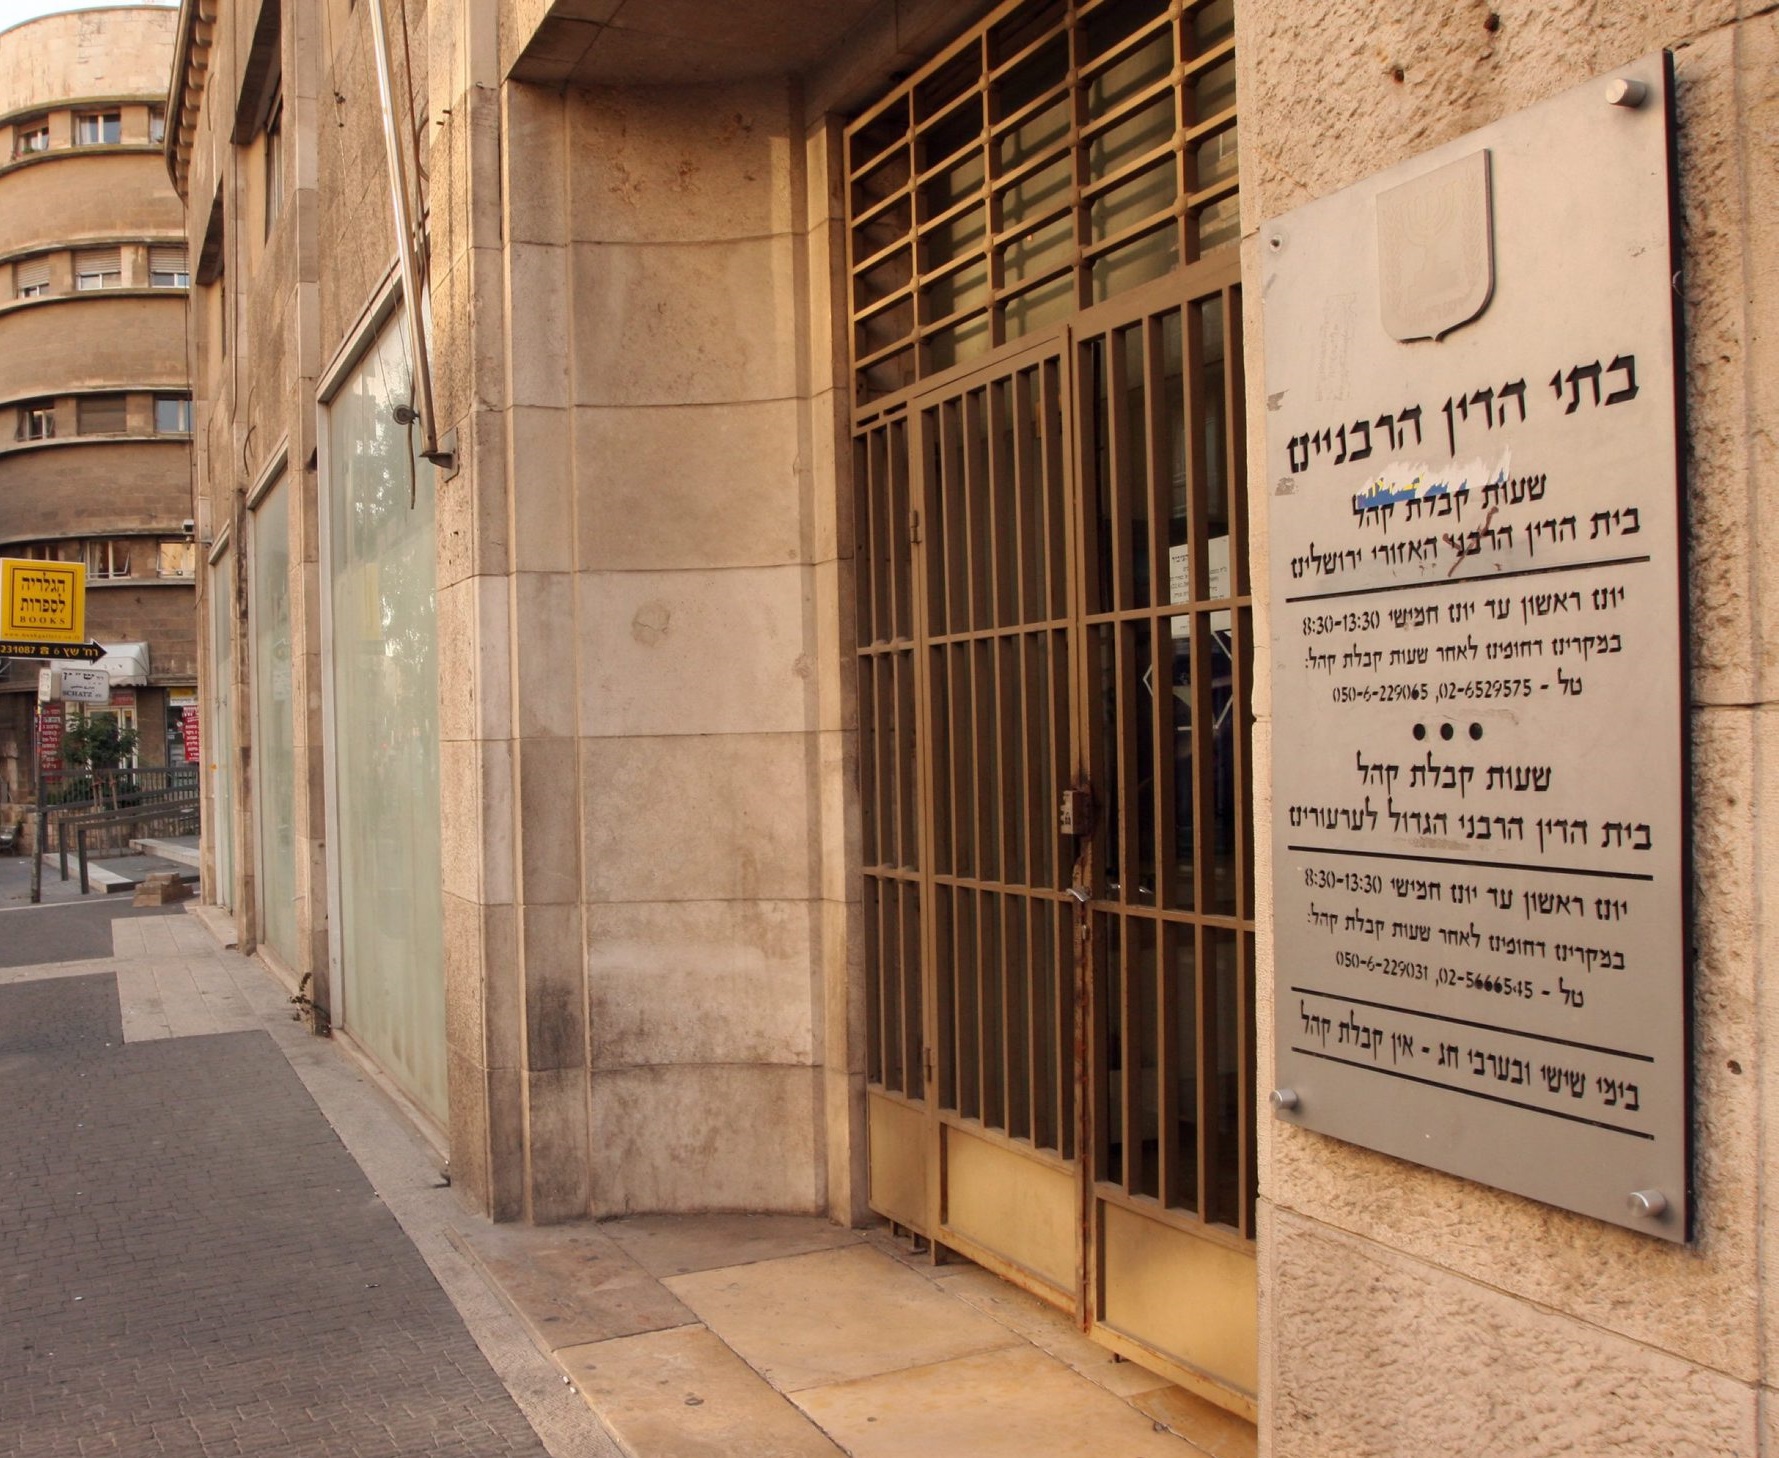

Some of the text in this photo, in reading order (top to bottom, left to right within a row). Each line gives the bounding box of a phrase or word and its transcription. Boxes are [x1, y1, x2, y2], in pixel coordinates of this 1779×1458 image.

[1286, 354, 1639, 474] בתי הדין הרבניים
[1481, 473, 1547, 510] שעות
[1352, 494, 1392, 534] קהל
[1291, 507, 1640, 578] בית הדין הרבני האזורי ירושלים
[22, 572, 66, 592] הגלריה
[20, 594, 66, 613] לספרות
[1302, 586, 1624, 636] יום ראשון עד יום חמישי 8:30-13:30
[20, 616, 66, 625] BOOKS
[63, 647, 80, 657] שץ
[1343, 643, 1382, 670] קבלת
[1390, 647, 1428, 665] שעות
[1436, 634, 1478, 661] לאחר
[1486, 639, 1543, 659] דחופים
[1552, 634, 1622, 659] במקרים
[1333, 683, 1428, 703] 050-6-229065
[1557, 667, 1582, 695] טל
[1356, 750, 1551, 798] שעות קבלת קהל
[1289, 796, 1652, 853] בית הדין הרבני הגדול לערעורים
[1304, 868, 1627, 920] יום ראשון עד יום חמישי 8:30-13:30
[1345, 908, 1385, 940] קבלת
[1392, 922, 1431, 942] שעות
[1438, 922, 1481, 948] לאחר
[1488, 935, 1546, 958] דחופים
[1554, 944, 1625, 972] במקרים
[1336, 951, 1428, 980] 050-6-229031
[1559, 977, 1584, 1008] טל
[1301, 999, 1331, 1046] קהל
[1338, 1011, 1383, 1060] קבלת
[1391, 1032, 1413, 1064] אין
[1438, 1043, 1459, 1068] חג
[1467, 1049, 1530, 1085] ובערבי
[1540, 1065, 1586, 1098] שישי
[1596, 1077, 1639, 1111] בימי
